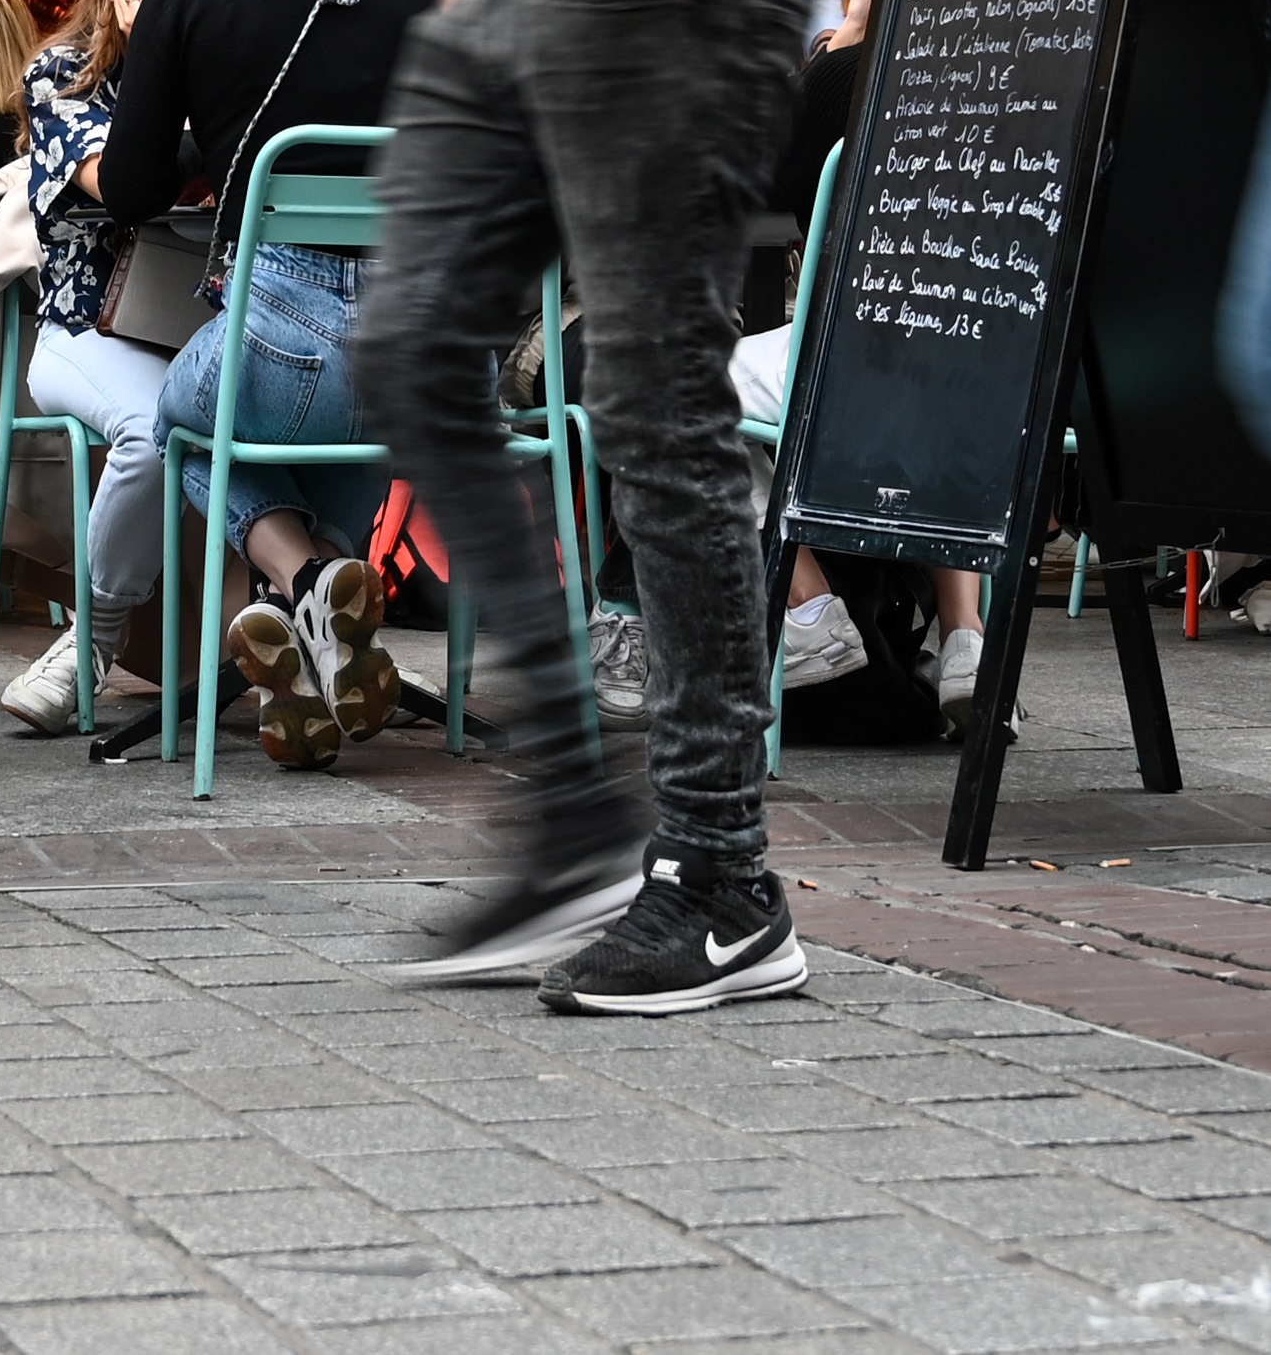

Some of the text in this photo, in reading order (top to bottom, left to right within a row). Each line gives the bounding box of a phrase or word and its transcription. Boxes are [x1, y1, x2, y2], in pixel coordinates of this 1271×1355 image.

[886, 146, 931, 180] Burger
[934, 149, 953, 172] du
[958, 147, 986, 180] Chef
[989, 159, 1006, 173] au
[879, 188, 922, 222] Burger
[899, 234, 916, 255] du
[962, 288, 977, 303] au
